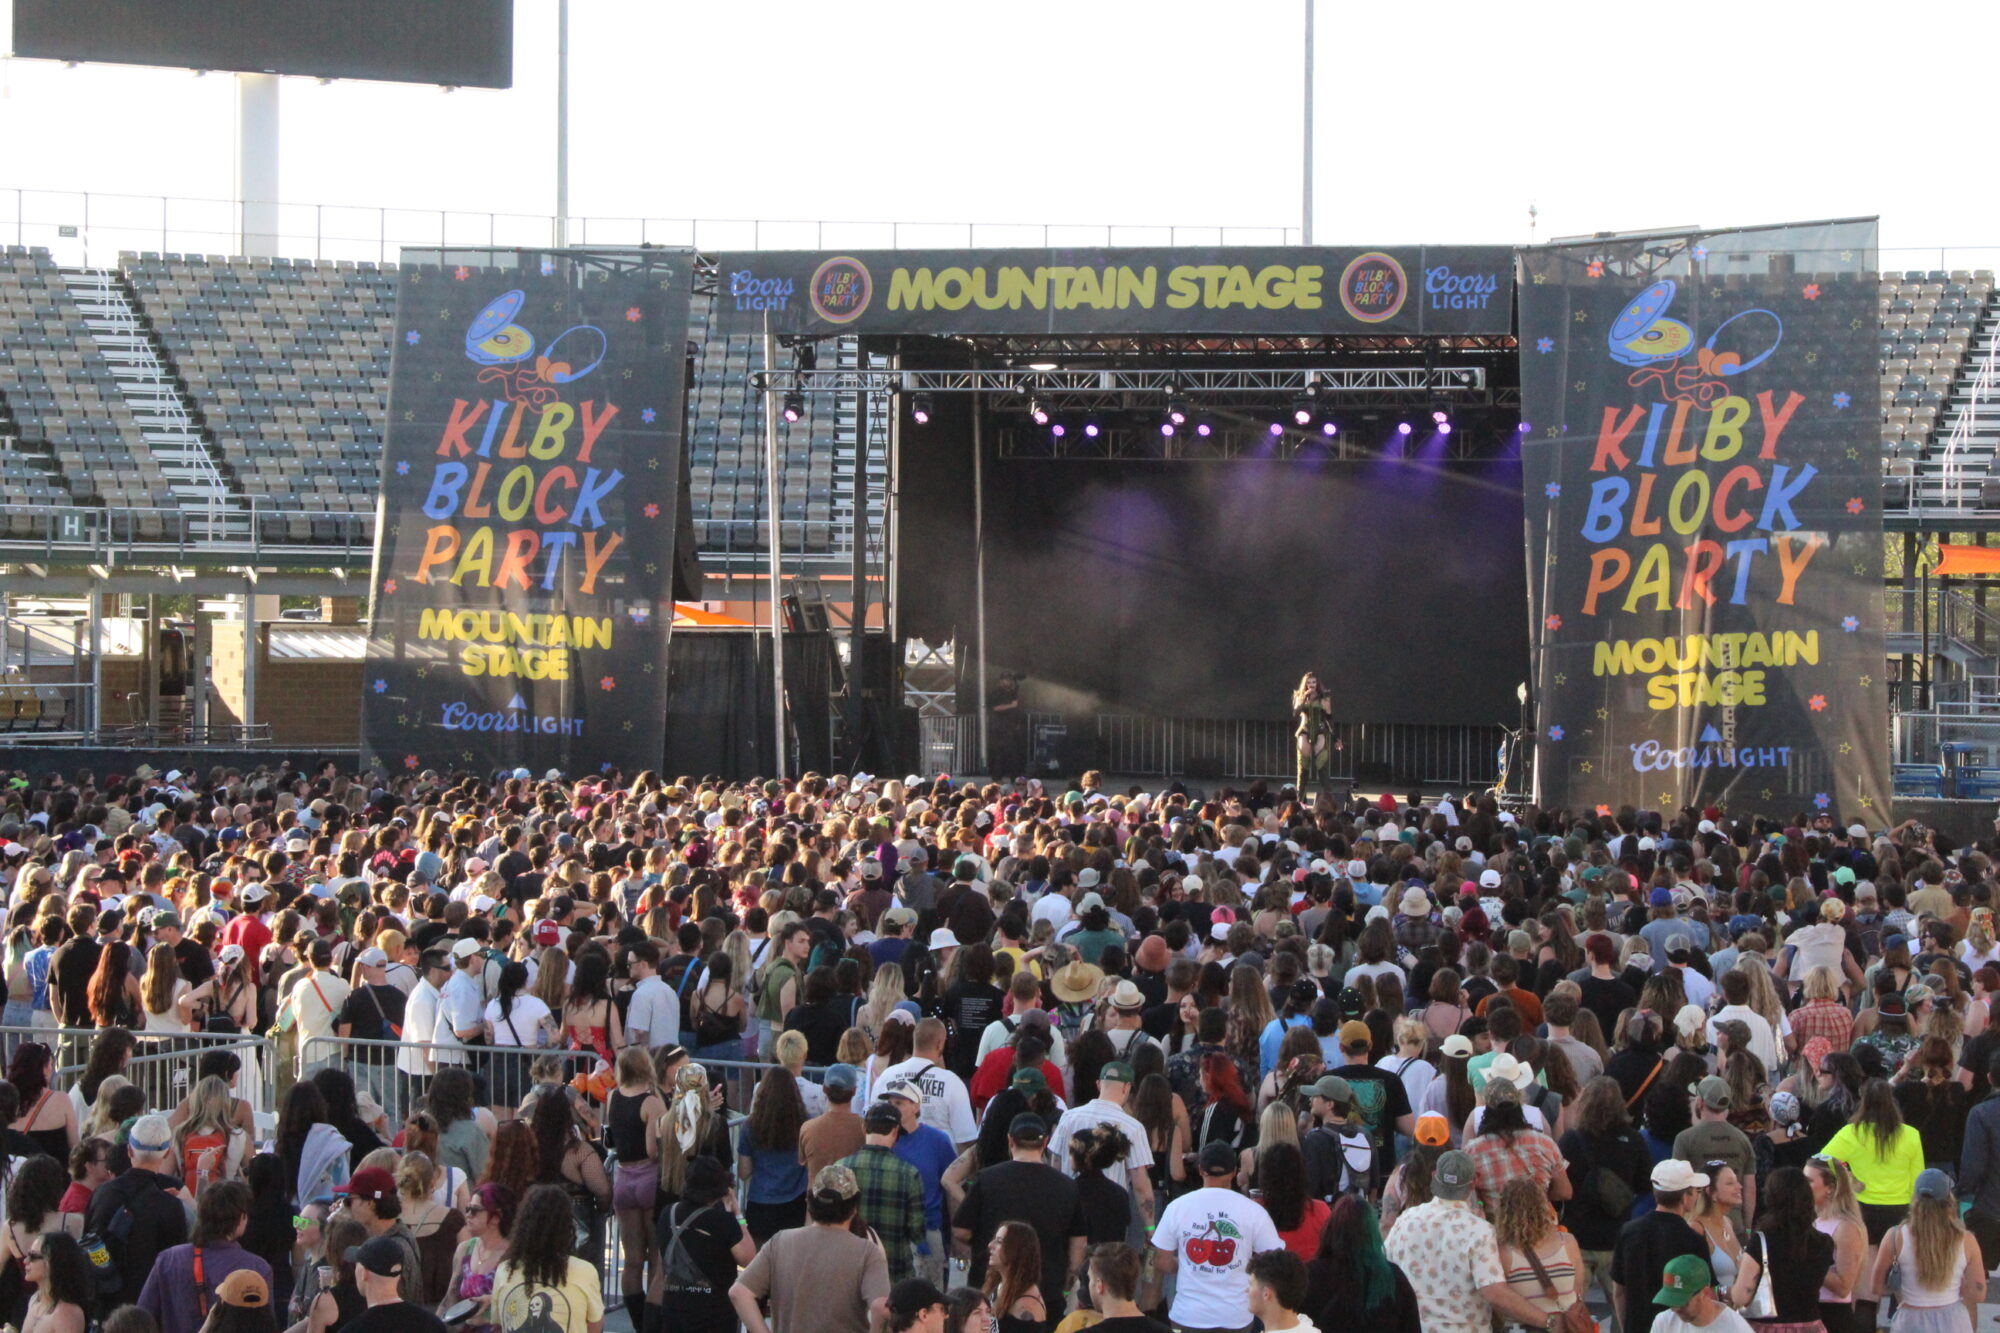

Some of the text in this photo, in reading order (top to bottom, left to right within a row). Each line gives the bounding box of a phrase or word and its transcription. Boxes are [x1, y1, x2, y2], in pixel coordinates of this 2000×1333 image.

[730, 269, 795, 296] Coors
[823, 284, 860, 294] BLOCK
[825, 272, 858, 284] KILBY
[887, 265, 1324, 310] MOUNTAIN STAGE
[1354, 282, 1393, 292] BLOCK
[1357, 269, 1392, 281] KILBY
[1424, 265, 1498, 294] Coors
[736, 297, 788, 311] LIGHT
[822, 295, 860, 306] PARTY
[1353, 293, 1393, 304] PARTY
[1432, 294, 1489, 309] LIGHT
[437, 398, 620, 463] KILBY
[1589, 389, 1806, 472] KILBY
[422, 461, 625, 529] BLOCK
[1580, 463, 1819, 543] BLOCK
[64, 515, 79, 536] H
[414, 525, 624, 595] PARTY
[1581, 533, 1825, 616] PARTY
[418, 608, 612, 650] MOUNTAIN
[461, 645, 569, 680] STAGE
[1593, 630, 1819, 677] MOUNTAIN
[1647, 670, 1767, 710] STAGE
[441, 701, 584, 737] Coors LIGHT
[1630, 739, 1791, 773] Coors LIGHT
[1192, 1222, 1208, 1230] Real
[1207, 1212, 1215, 1220] To
[1218, 1211, 1229, 1219] Me
